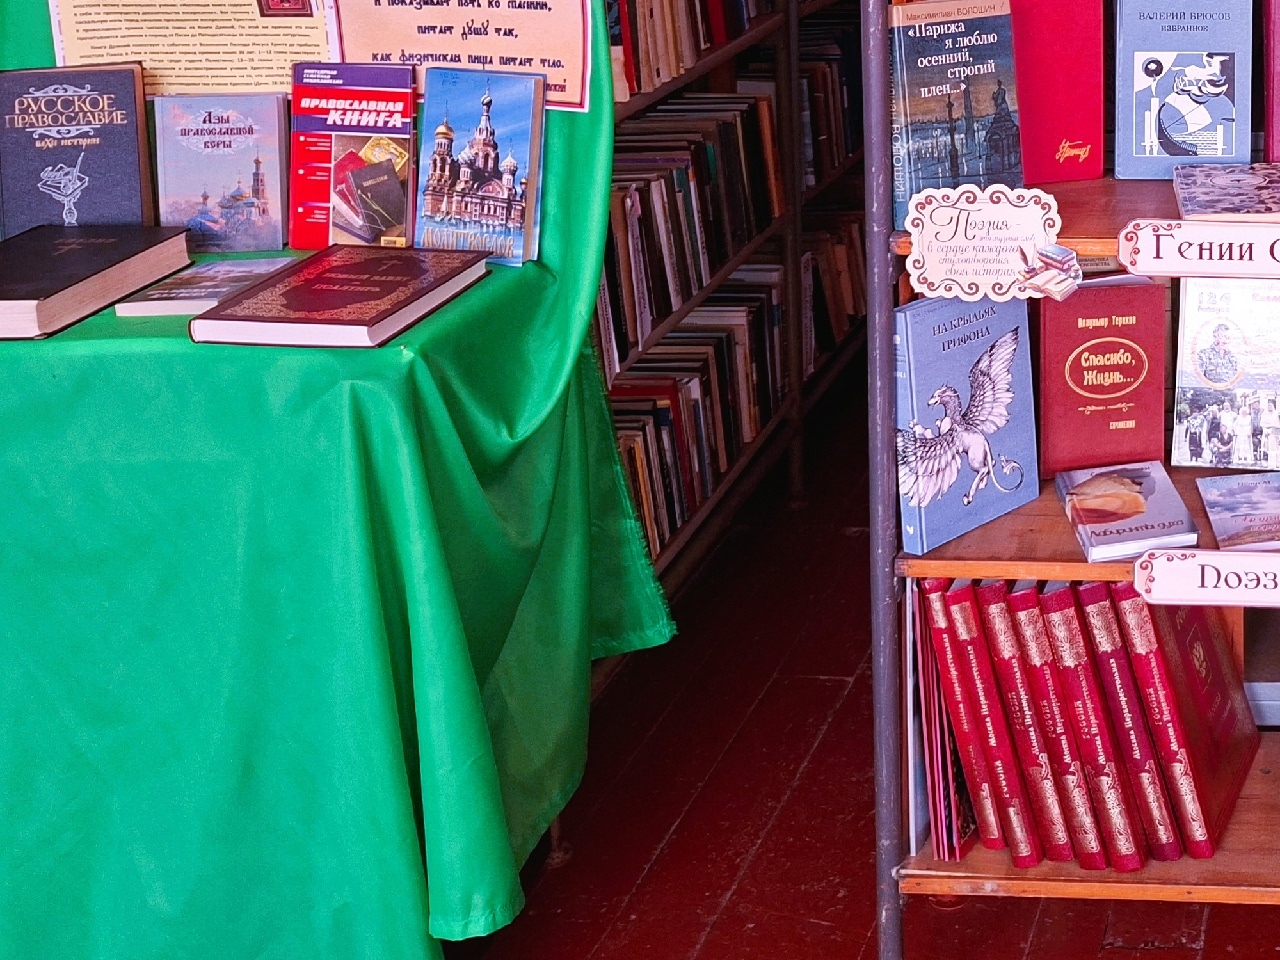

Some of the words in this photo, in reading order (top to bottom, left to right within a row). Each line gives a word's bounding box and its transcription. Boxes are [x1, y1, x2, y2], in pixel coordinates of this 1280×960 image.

[906, 8, 956, 21] Максимилиан
[956, 5, 997, 16] ВОЛОШИН
[1138, 10, 1187, 21] ВАЛЕРИЙ
[1189, 10, 1231, 21] БРЮСОВ
[907, 22, 965, 38] «Парижа
[1161, 24, 1209, 32] ИЗБРАННОЕ
[944, 38, 953, 49] я
[956, 32, 998, 48] люблю
[917, 50, 973, 68] осенний,
[947, 61, 996, 80] строгий
[920, 82, 967, 98] плен...»
[15, 94, 117, 114] РУССКОЕ
[300, 97, 404, 113] ПРАВОСЛАВНАЯ
[4, 110, 128, 128] ПРАВОСЛАВИЕ
[202, 111, 230, 125] Азы
[929, 205, 1012, 243] Поэзия
[1152, 233, 1254, 261] Гении
[938, 253, 1009, 269] стихотворения
[944, 264, 968, 276] своя
[971, 266, 1017, 279] история
[932, 324, 949, 338] НА
[950, 305, 997, 331] КРЫЛЬЯХ
[941, 326, 991, 353] ГРИФОНА
[1080, 348, 1136, 368] Спасибо,
[1082, 370, 1134, 386] Жизнь...
